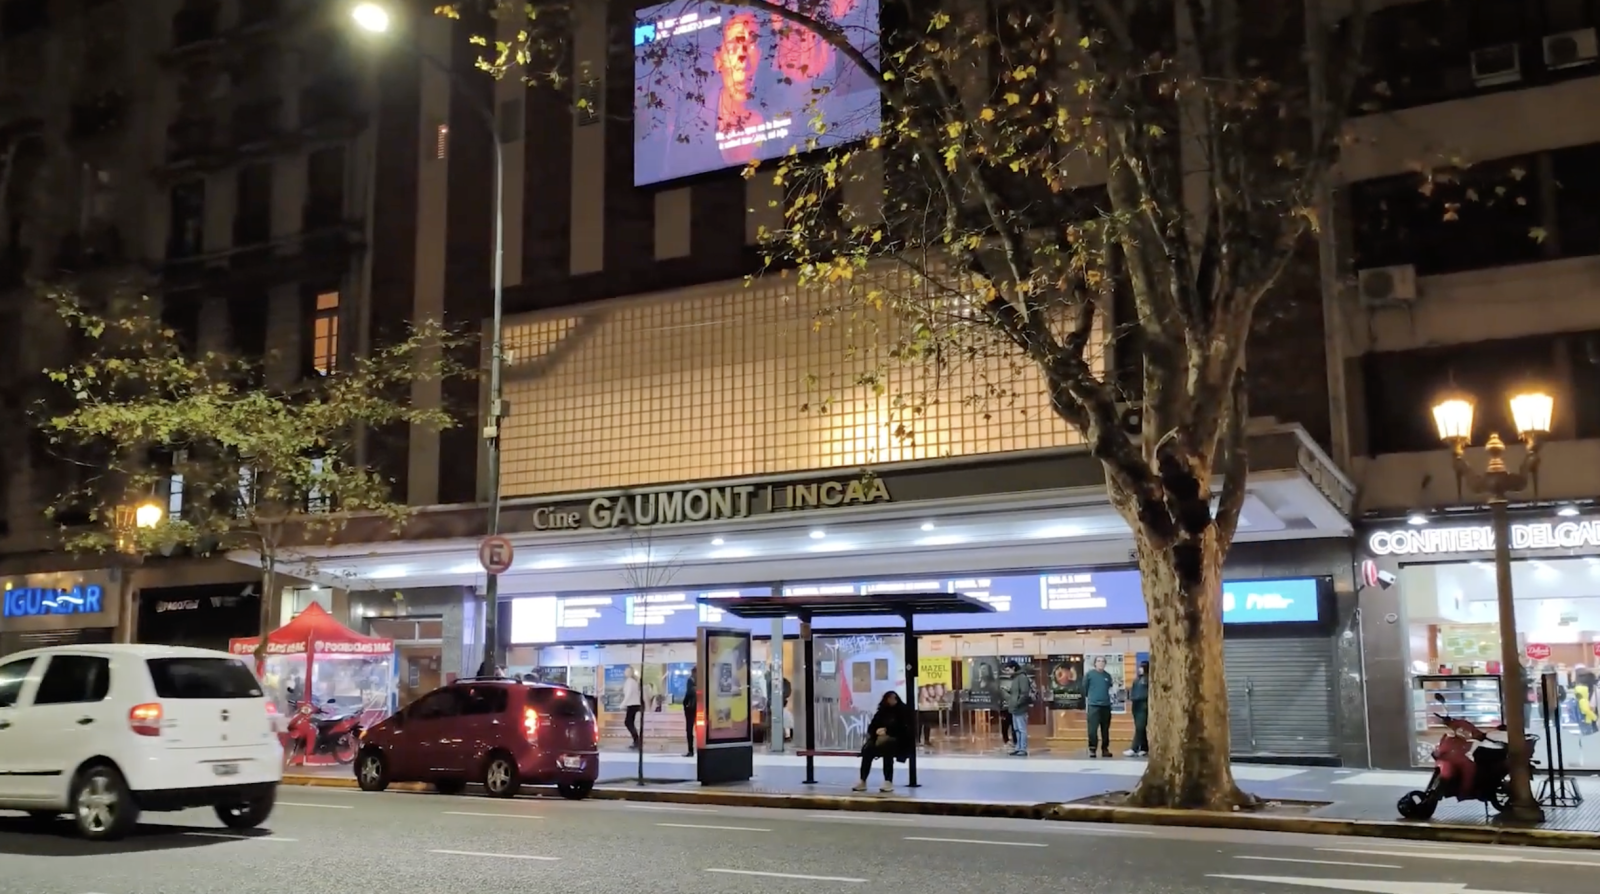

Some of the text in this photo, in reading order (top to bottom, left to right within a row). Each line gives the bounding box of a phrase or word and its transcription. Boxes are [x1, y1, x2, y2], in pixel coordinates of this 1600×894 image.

[533, 477, 890, 530] Cine GAUMONT INCAA
[920, 664, 949, 673] MAZEL
